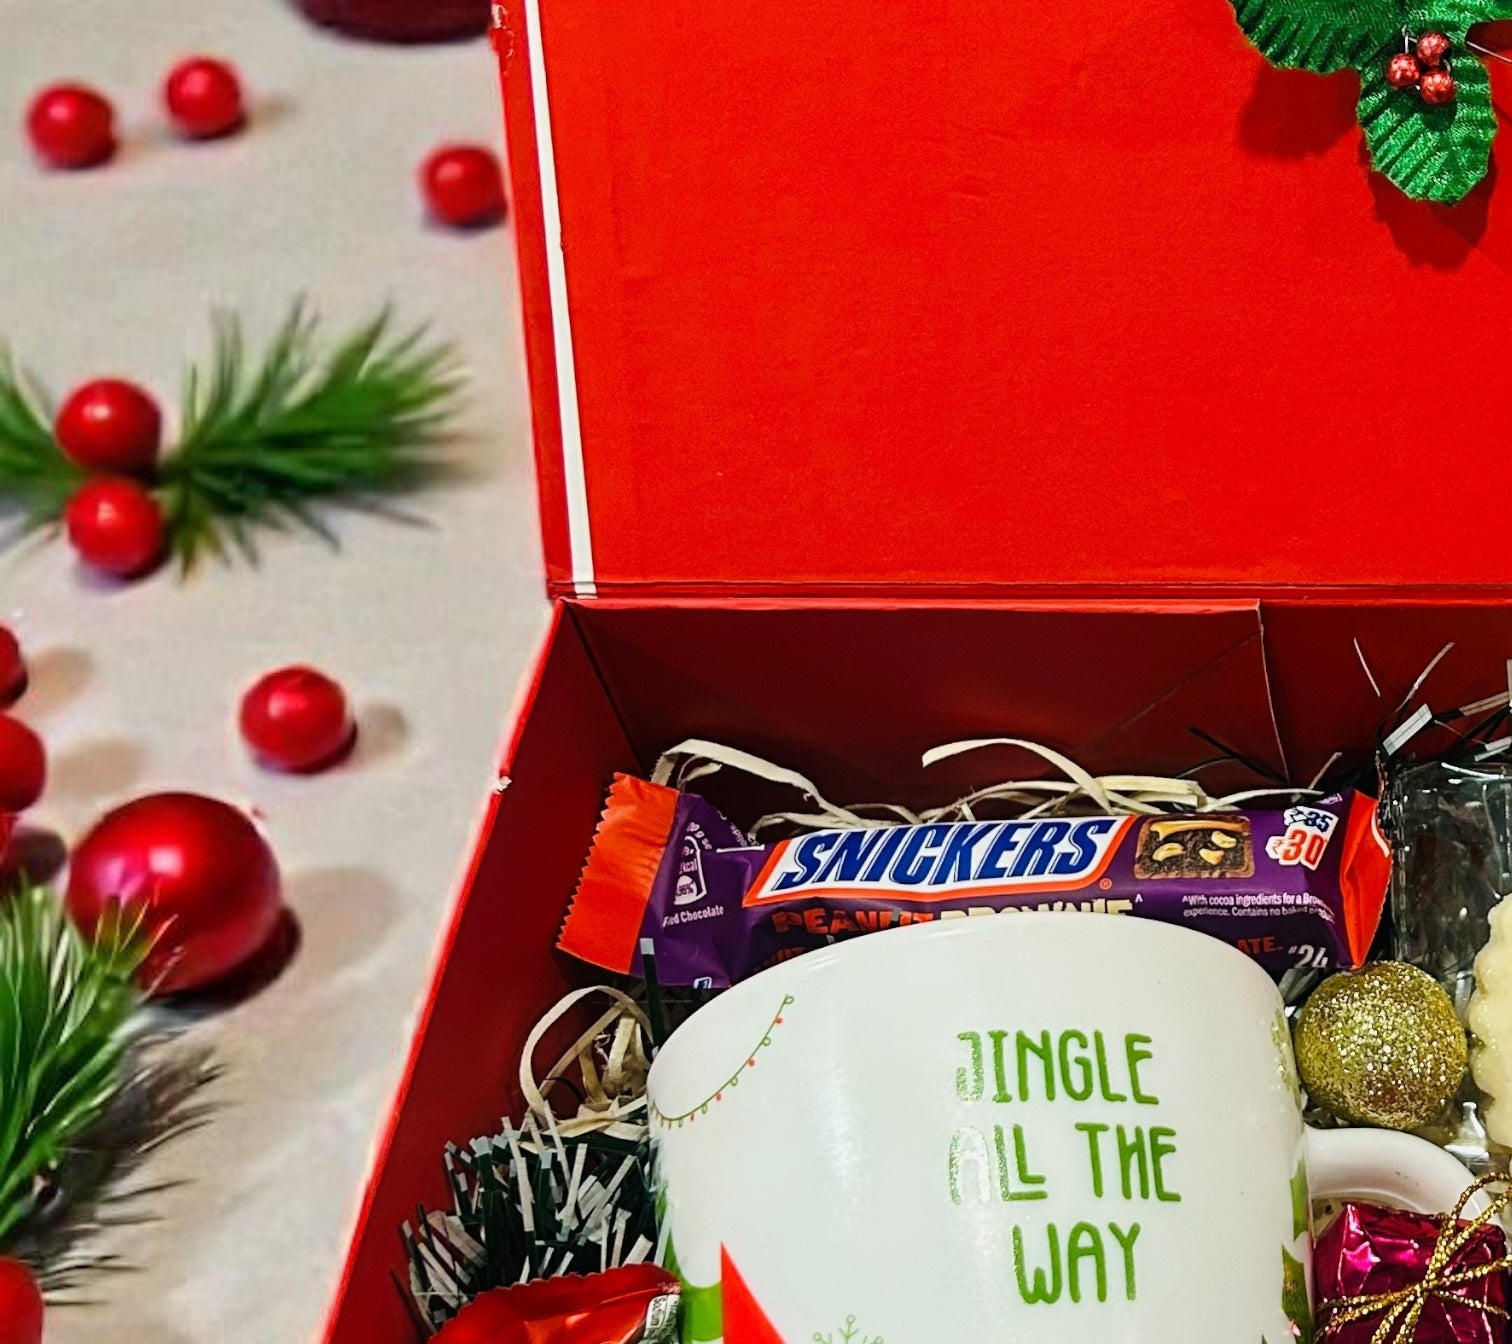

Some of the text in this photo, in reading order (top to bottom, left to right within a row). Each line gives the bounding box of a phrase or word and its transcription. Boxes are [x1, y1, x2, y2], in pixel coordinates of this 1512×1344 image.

[771, 819, 1117, 891] SNICKERS
[680, 904, 725, 923] Chocolate
[1209, 895, 1234, 906] cocoa
[1236, 893, 1282, 907] ingredients
[1283, 892, 1295, 905] for
[1231, 906, 1268, 917] Contains
[1269, 907, 1280, 917] no
[956, 1029, 1159, 1105] JINGLE
[949, 1122, 1182, 1205] ALL THE
[1012, 1221, 1140, 1304] WAY
